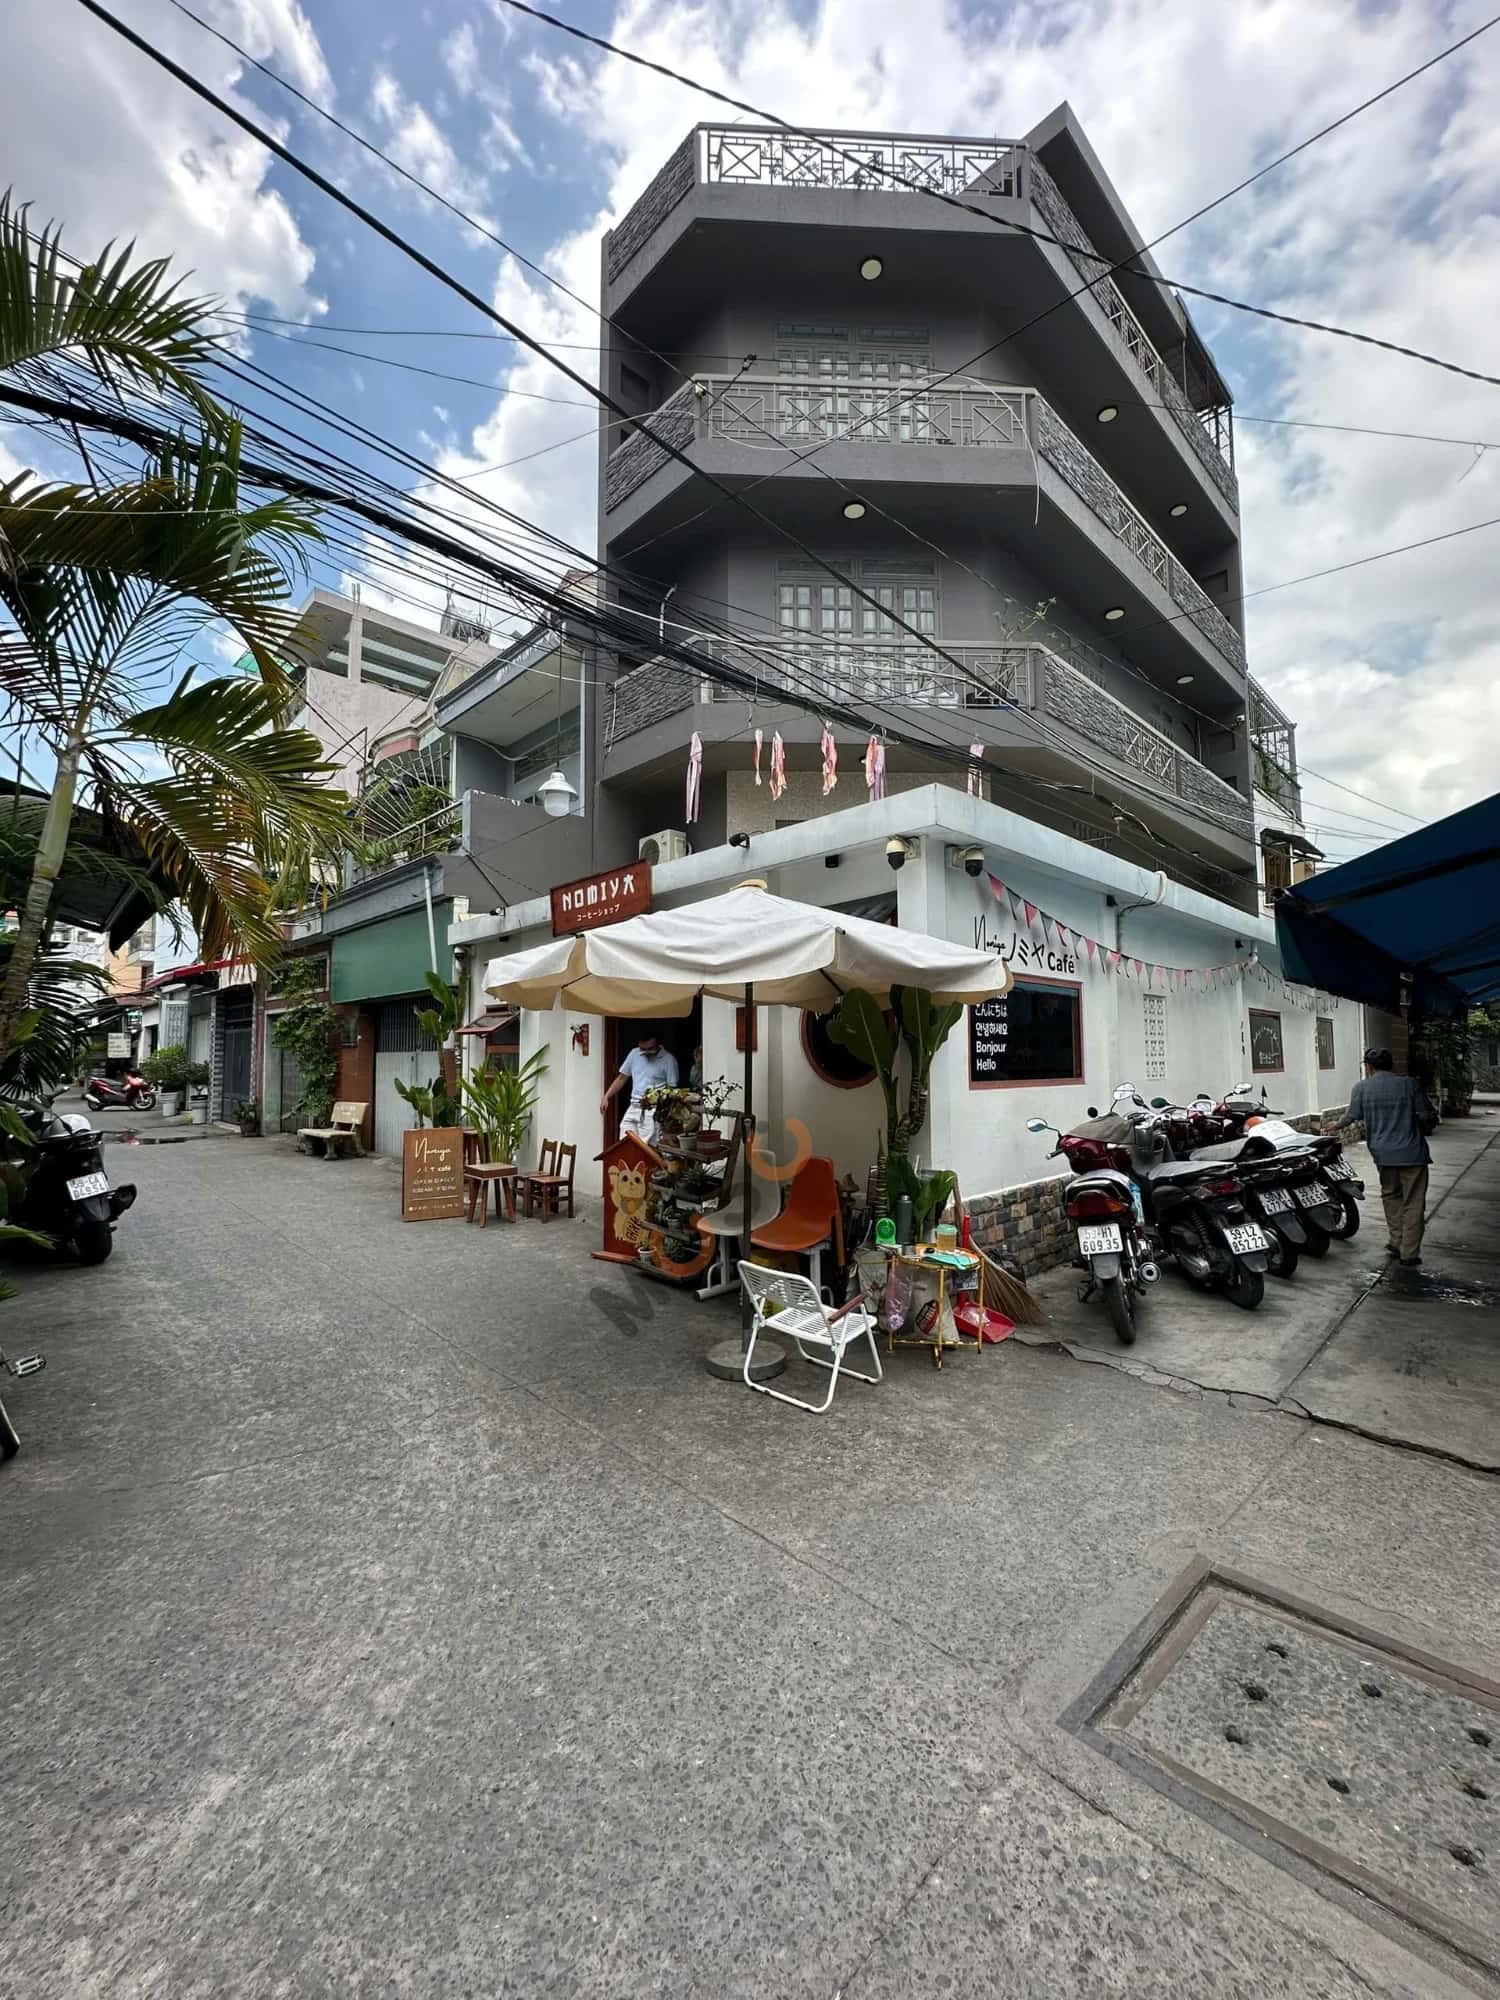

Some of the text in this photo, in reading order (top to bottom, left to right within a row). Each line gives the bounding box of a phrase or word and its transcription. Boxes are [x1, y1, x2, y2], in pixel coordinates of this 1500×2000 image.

[1047, 951, 1075, 973] Café
[975, 1022, 1008, 1036] 안녕하세요
[976, 1041, 1007, 1056] Bonjour
[976, 1058, 997, 1071] Hello
